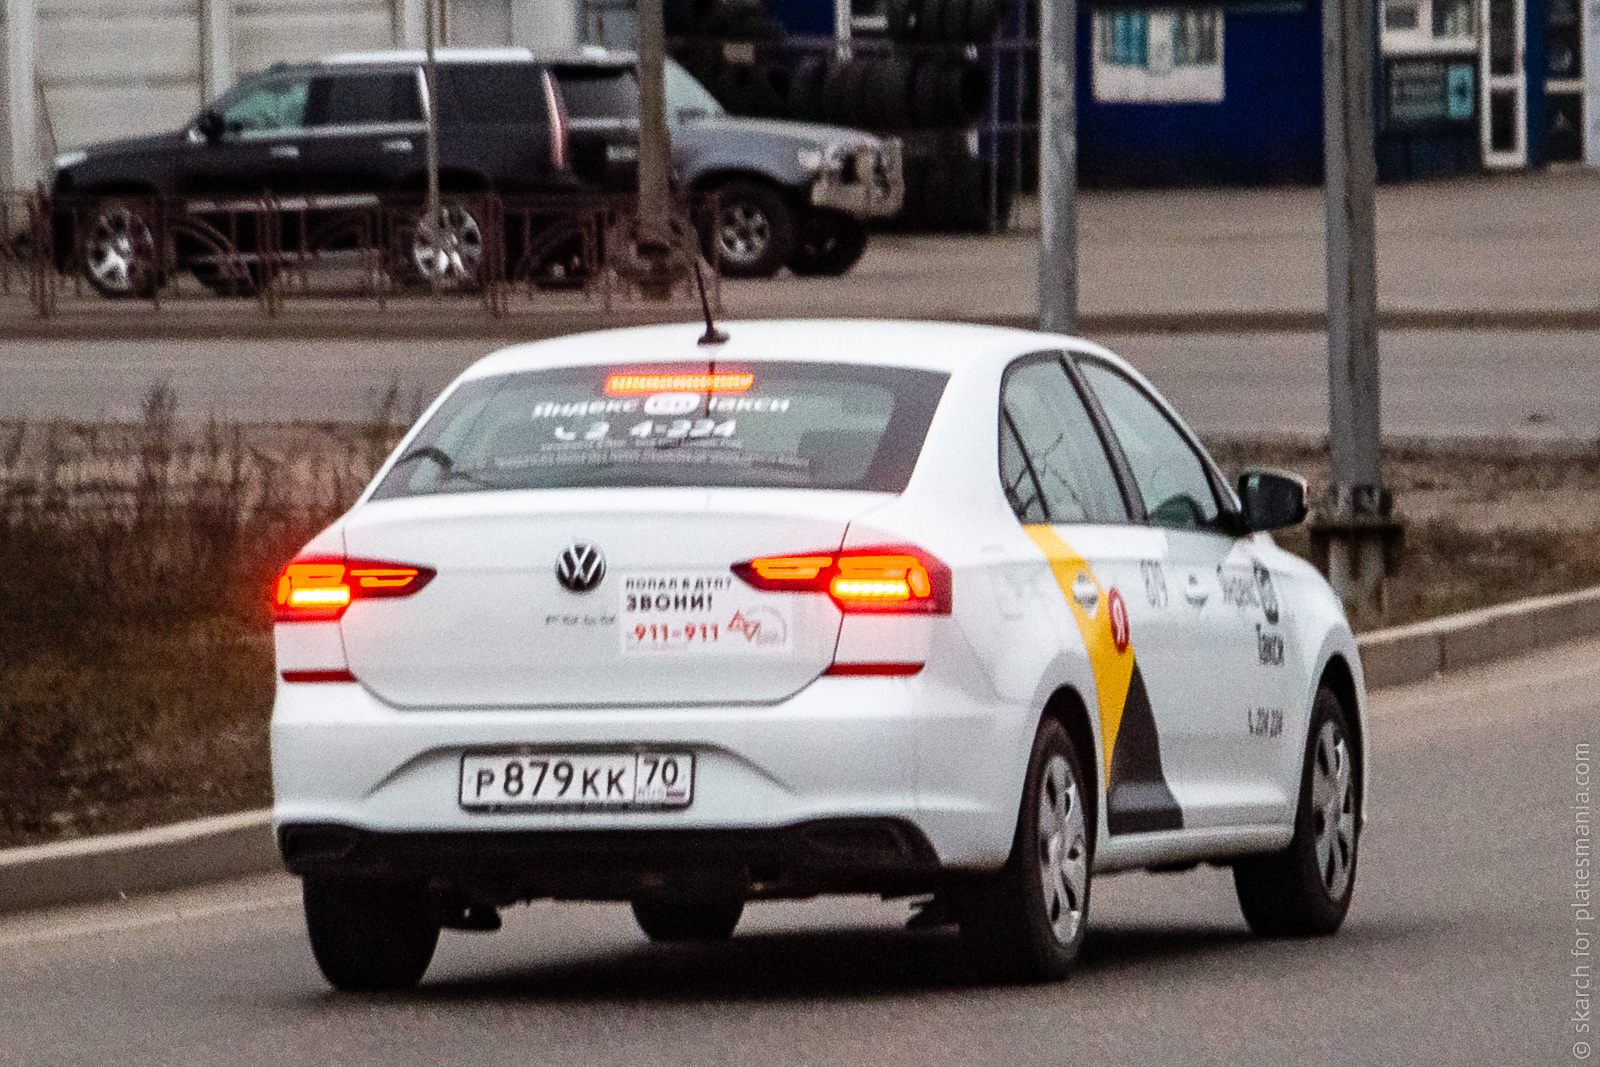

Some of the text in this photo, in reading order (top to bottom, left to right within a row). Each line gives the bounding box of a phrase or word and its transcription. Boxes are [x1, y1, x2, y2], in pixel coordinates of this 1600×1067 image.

[626, 594, 713, 612] ЗВОНИ!
[634, 623, 719, 642] 911-911
[643, 757, 679, 786] 70
